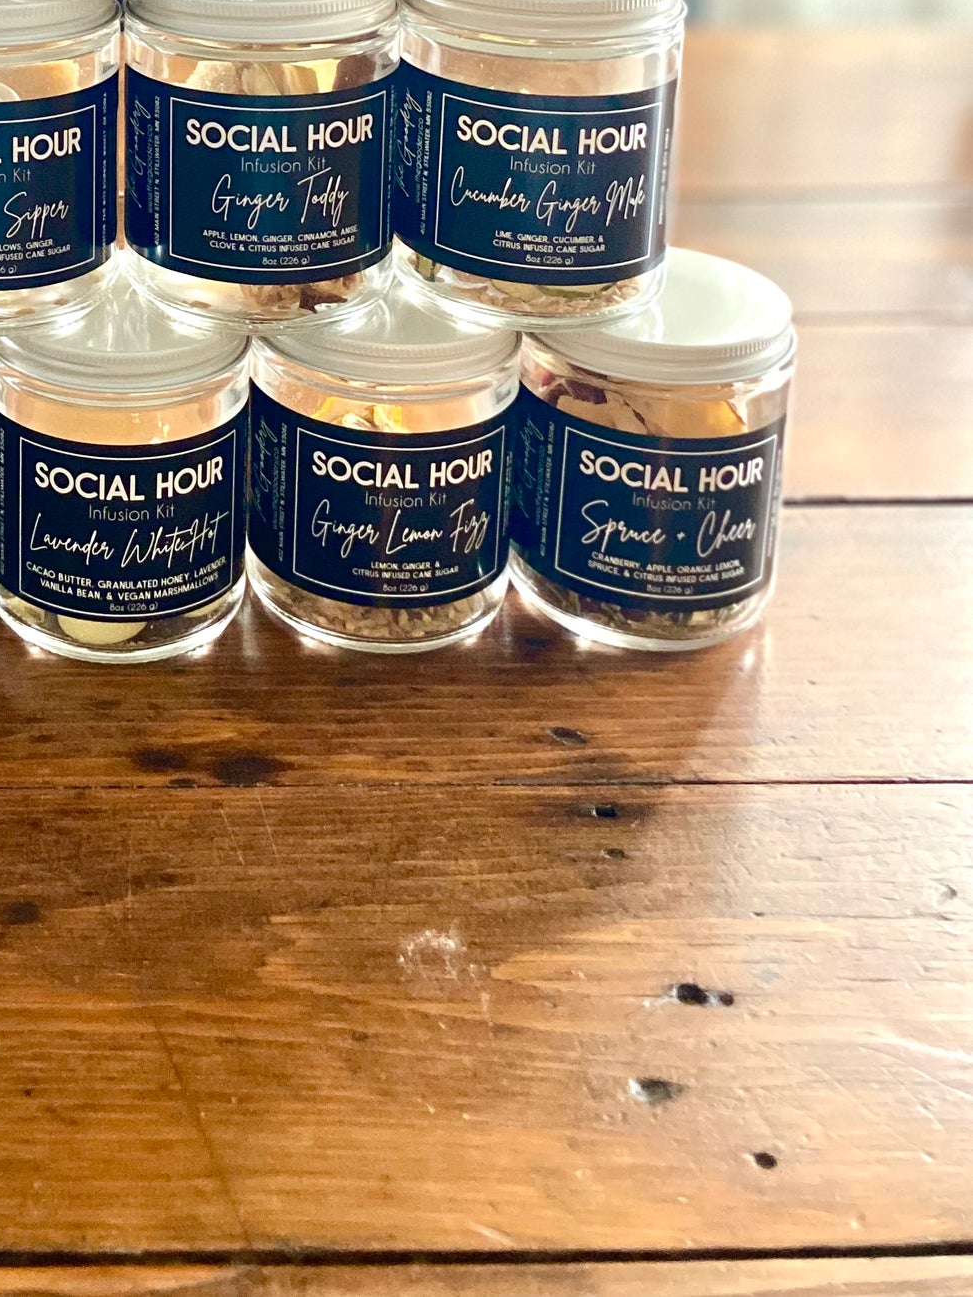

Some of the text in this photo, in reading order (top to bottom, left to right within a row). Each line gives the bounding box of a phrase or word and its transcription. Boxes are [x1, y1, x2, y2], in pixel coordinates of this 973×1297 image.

[12, 127, 81, 163] HOUR
[186, 114, 373, 153] SOCIAL HOUR
[456, 115, 647, 155] SOCIAL HOUR
[13, 168, 31, 182] Kit
[241, 156, 326, 174] Infusion Kit
[510, 155, 596, 175] Infusion Kit
[3, 191, 69, 239] Sipper
[211, 167, 350, 230] Ginger Toddy
[450, 166, 531, 213] Cucumber
[536, 180, 601, 233] Ginger
[34, 455, 224, 501] SOCIAL HOUR
[312, 449, 493, 489] SOCIAL HOUR
[579, 450, 764, 493] SOCIAL HOUR
[89, 504, 174, 521] Infusion Kit
[365, 491, 447, 508] Infusion Kit
[632, 493, 716, 510] Infusion Kit
[29, 512, 114, 566] Lavender
[311, 498, 491, 558] Ginger Lemon Fizz
[580, 499, 666, 553] Spruce
[697, 510, 756, 557] Cheer
[26, 561, 56, 578] CACAO
[58, 571, 94, 589] BUTTER,
[97, 578, 158, 589] GRANULATED
